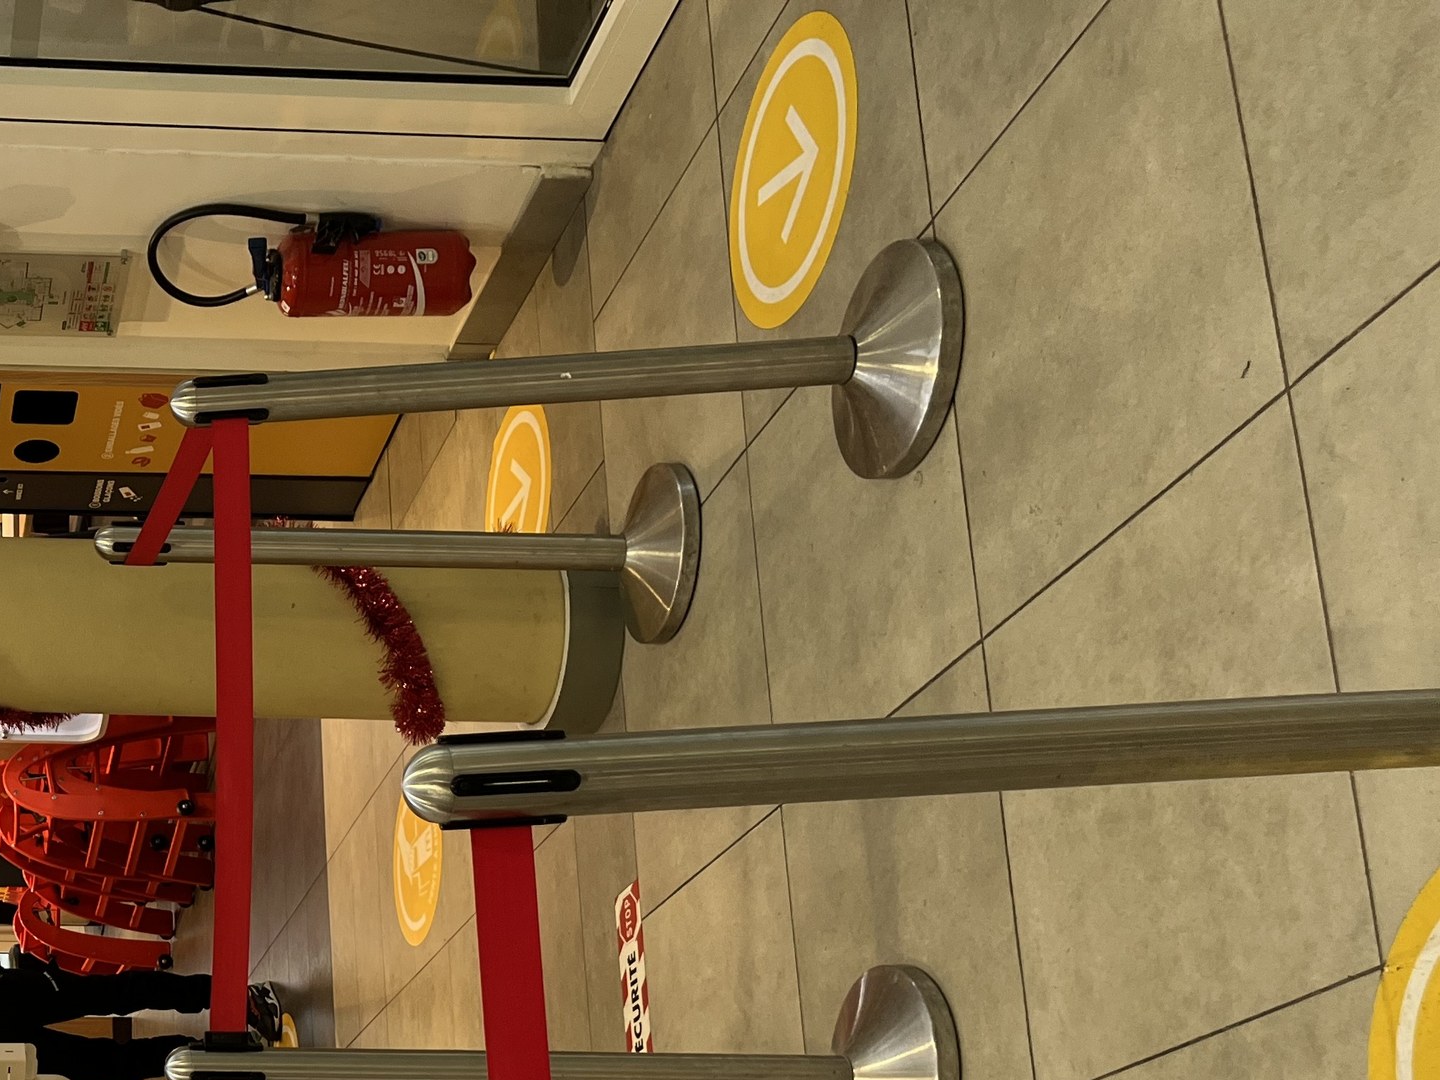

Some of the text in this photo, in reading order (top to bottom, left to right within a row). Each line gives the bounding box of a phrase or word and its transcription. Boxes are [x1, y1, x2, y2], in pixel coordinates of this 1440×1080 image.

[92, 480, 104, 502] BOISSONS
[102, 480, 115, 502] GLAÇONS
[622, 899, 635, 938] STOP
[625, 951, 644, 1053] ÉCURITÉ
